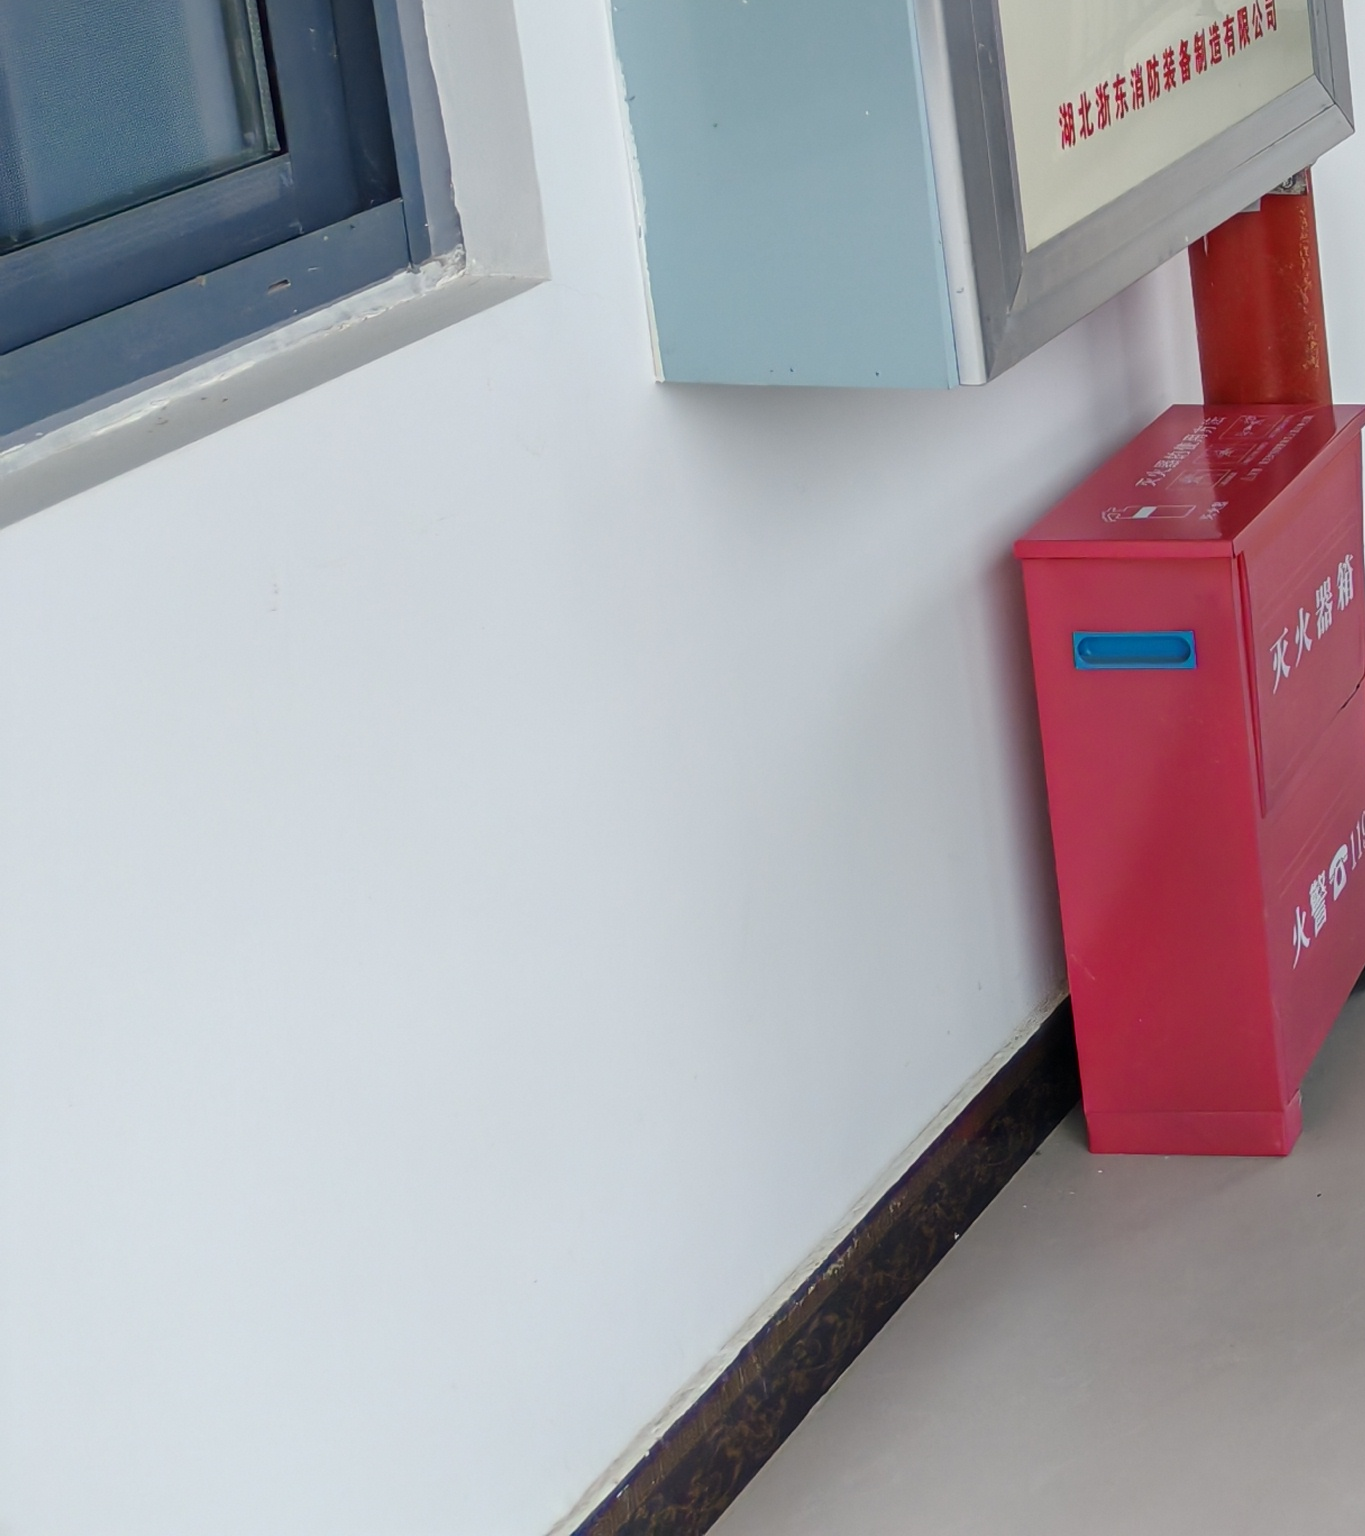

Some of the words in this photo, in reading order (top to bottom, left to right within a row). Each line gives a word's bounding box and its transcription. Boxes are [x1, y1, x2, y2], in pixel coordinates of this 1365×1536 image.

[1134, 416, 1227, 488] 灭火器的使用方法
[1269, 554, 1355, 695] 灭火器箱
